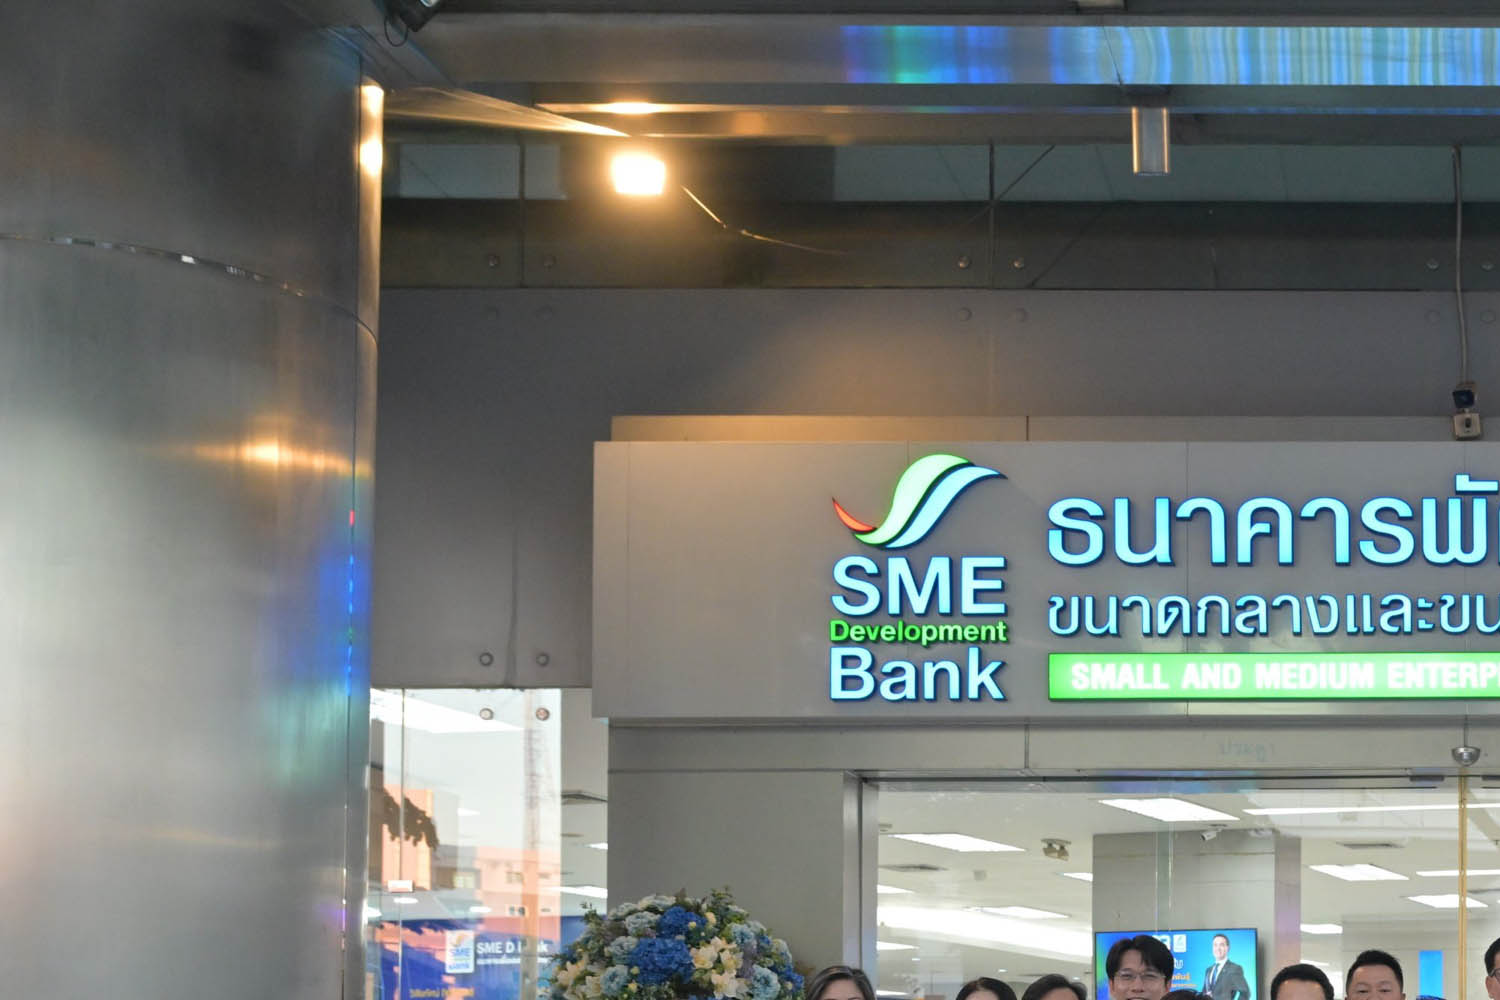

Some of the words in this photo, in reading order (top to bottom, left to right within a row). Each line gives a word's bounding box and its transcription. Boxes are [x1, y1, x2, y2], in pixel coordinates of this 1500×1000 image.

[831, 556, 1007, 617] SME
[829, 620, 1008, 645] Development
[829, 646, 1007, 701] Bank
[1070, 661, 1169, 690] SMALL
[1182, 661, 1242, 690] AND
[1254, 661, 1375, 690] MEDIUM
[476, 941, 503, 955] SME
